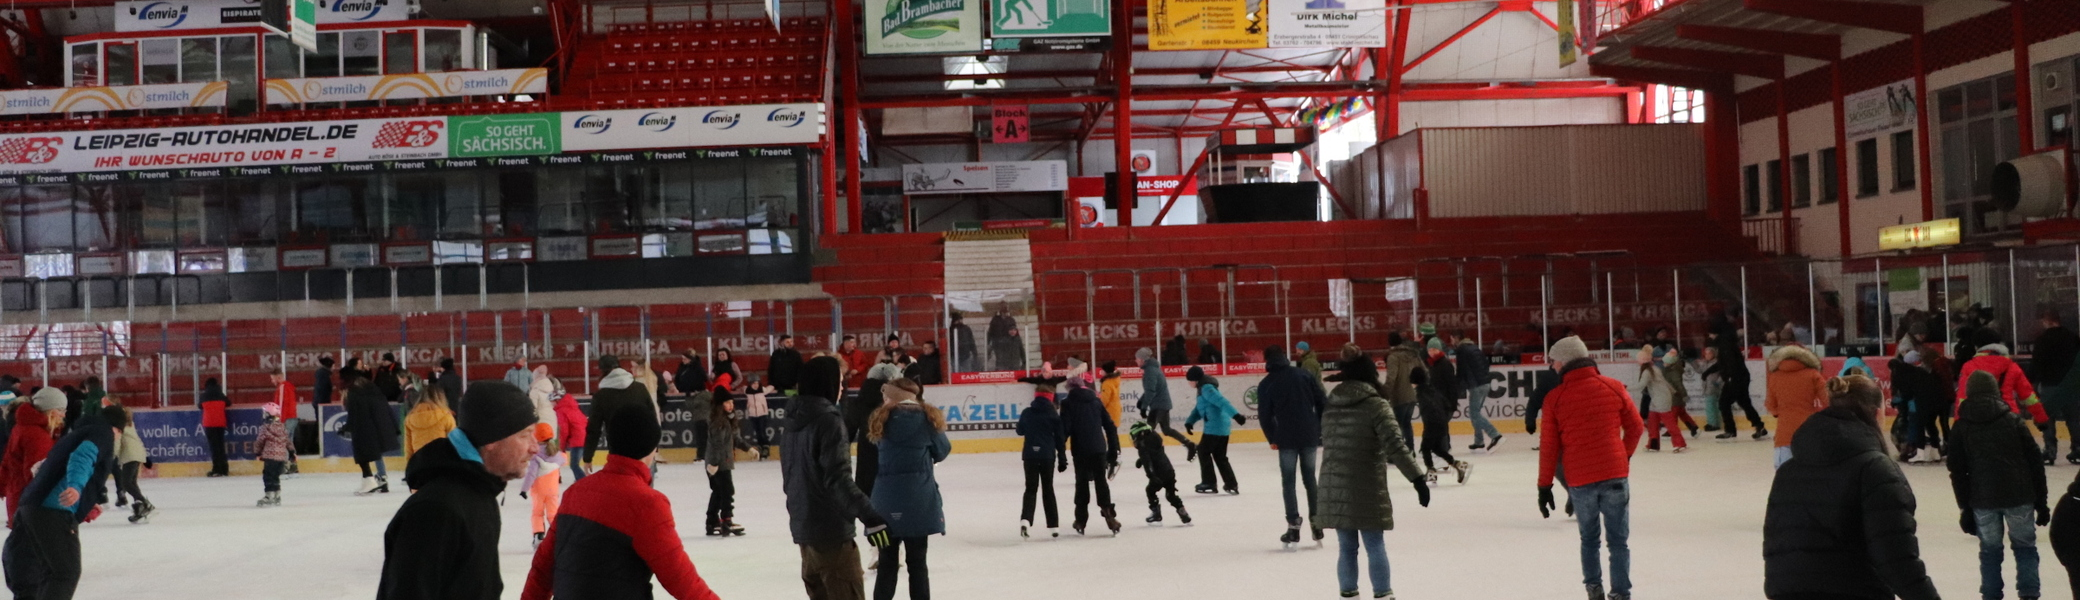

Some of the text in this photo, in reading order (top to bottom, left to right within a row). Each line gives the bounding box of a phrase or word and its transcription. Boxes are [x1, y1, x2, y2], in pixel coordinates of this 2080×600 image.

[883, 0, 960, 33] Bad Brambacher
[995, 109, 1026, 118] Block
[486, 124, 535, 137] SO GEHT
[1004, 119, 1019, 138] A
[73, 124, 358, 150] LEIPZIG-AUTOHANDEL.DE
[463, 135, 546, 153] SÄCHSISCH.
[655, 151, 687, 160] freenet
[707, 149, 739, 158] freenet
[760, 147, 792, 156] freenet
[94, 156, 123, 168] IHR
[128, 151, 246, 166] WUNSCHAUTO
[251, 149, 285, 161] VON
[290, 148, 303, 160] A
[498, 157, 529, 165] freenet
[550, 155, 582, 164] freenet
[602, 153, 634, 161] freenet
[343, 162, 374, 171] freenet
[394, 160, 425, 169] freenet
[446, 159, 477, 167] freenet
[190, 169, 221, 177] freenet
[241, 167, 272, 175] freenet
[292, 165, 322, 173] freenet
[37, 174, 68, 183] freenet
[88, 172, 119, 181] freenet
[139, 170, 170, 179] freenet
[1137, 180, 1179, 189] AN-SHOP
[1530, 307, 1601, 323] KLECKS
[1174, 320, 1259, 336] КЛЯКСА
[1301, 316, 1376, 333] KLECKS
[1063, 323, 1139, 340] KLECKS
[718, 338, 782, 352] KLECK
[363, 348, 444, 366] КЛКСА
[479, 344, 553, 362] KECKS
[1164, 364, 1218, 374] EASYWUNG
[961, 371, 1015, 380] EASYWERBUNG
[1119, 390, 1138, 400] ank
[1452, 400, 1526, 419] Sevice
[143, 423, 190, 438] wollen.
[947, 422, 1017, 430] ERTECHNIK
